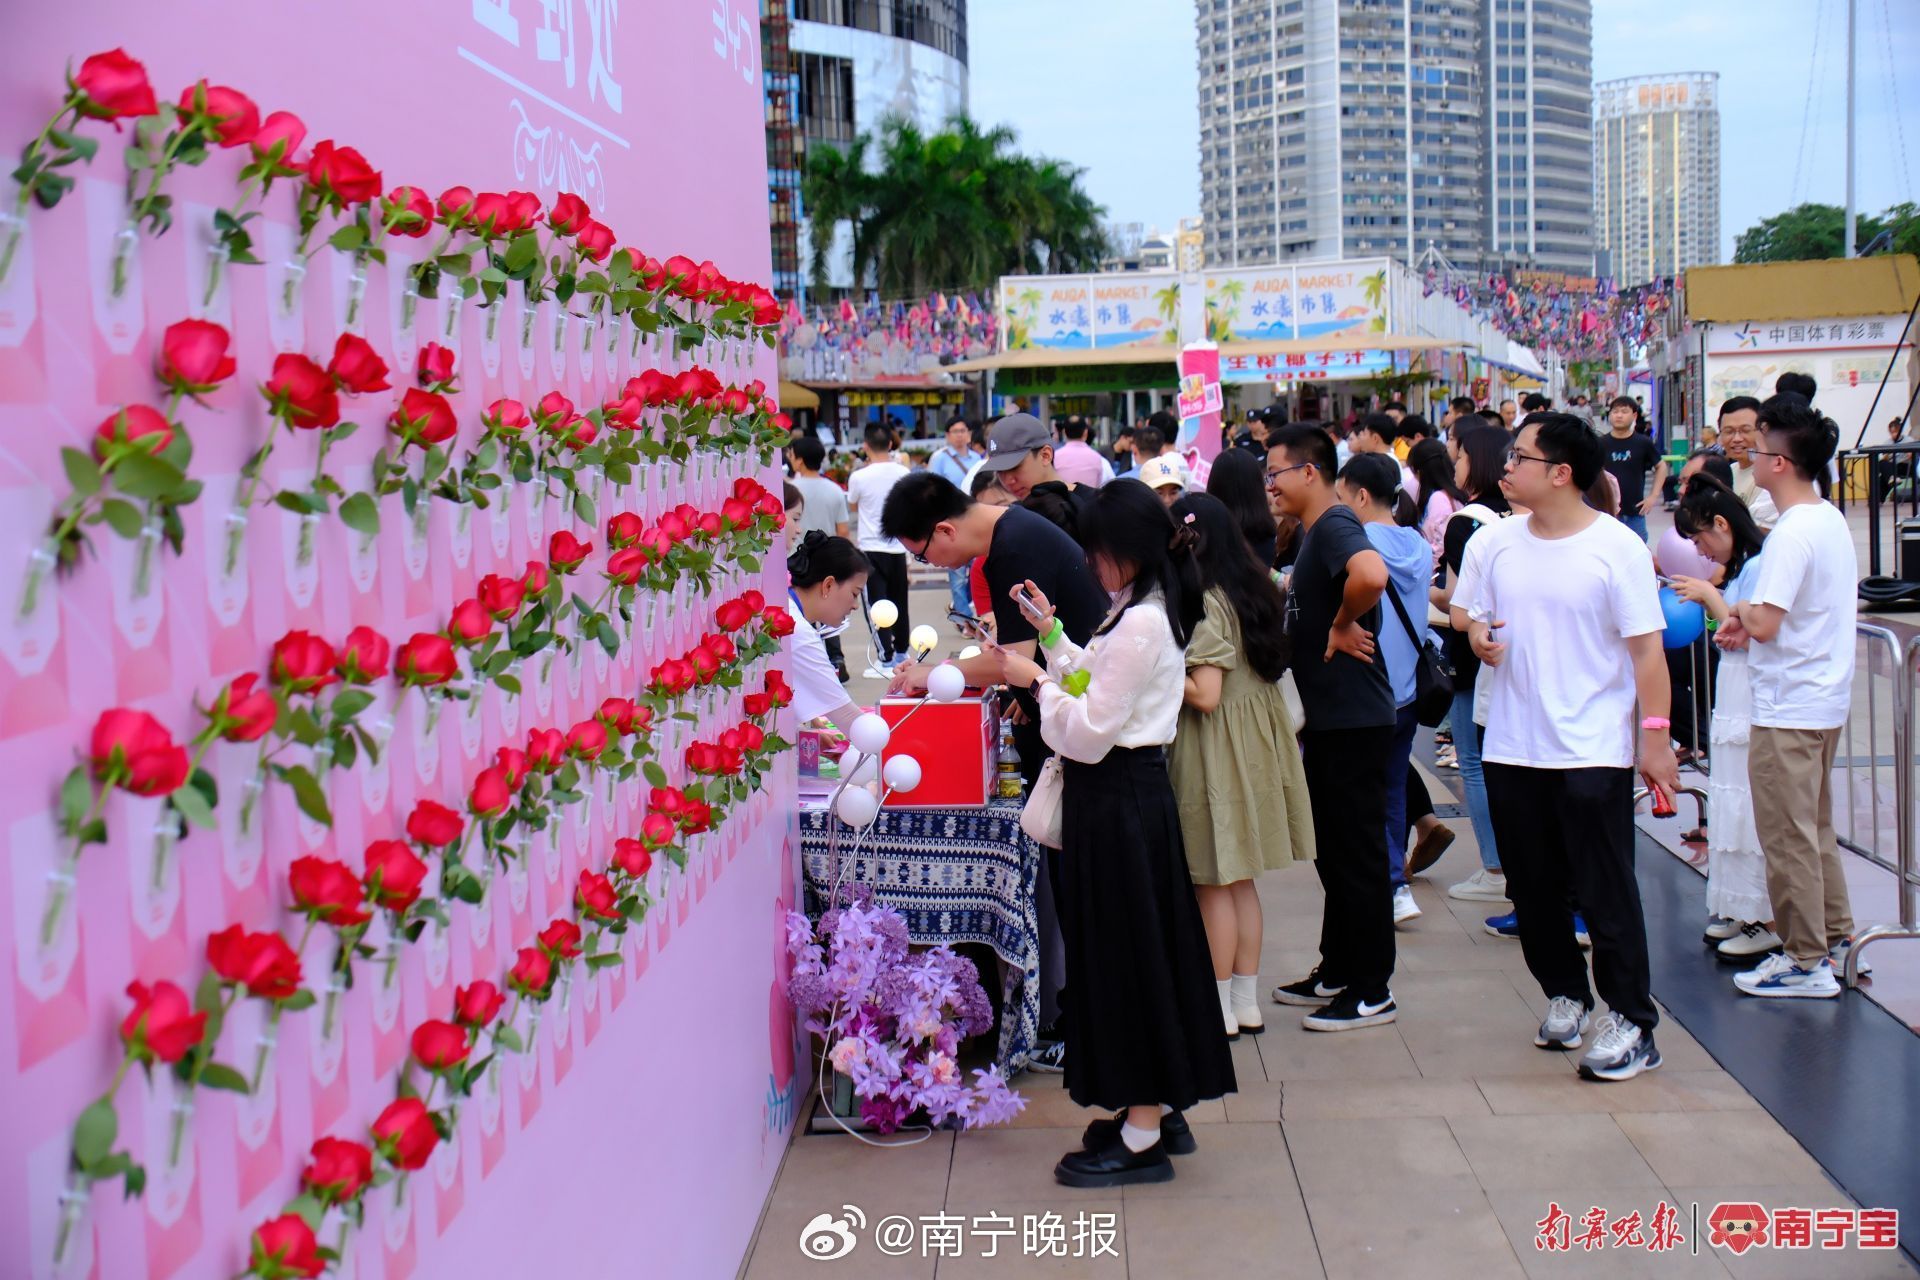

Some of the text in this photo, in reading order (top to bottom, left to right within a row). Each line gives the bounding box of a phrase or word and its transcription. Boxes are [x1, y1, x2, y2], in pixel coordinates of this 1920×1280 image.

[1299, 273, 1354, 289] MARKET
[1095, 286, 1149, 300] MARKET
[1769, 322, 1885, 343] 中国体育彩票
